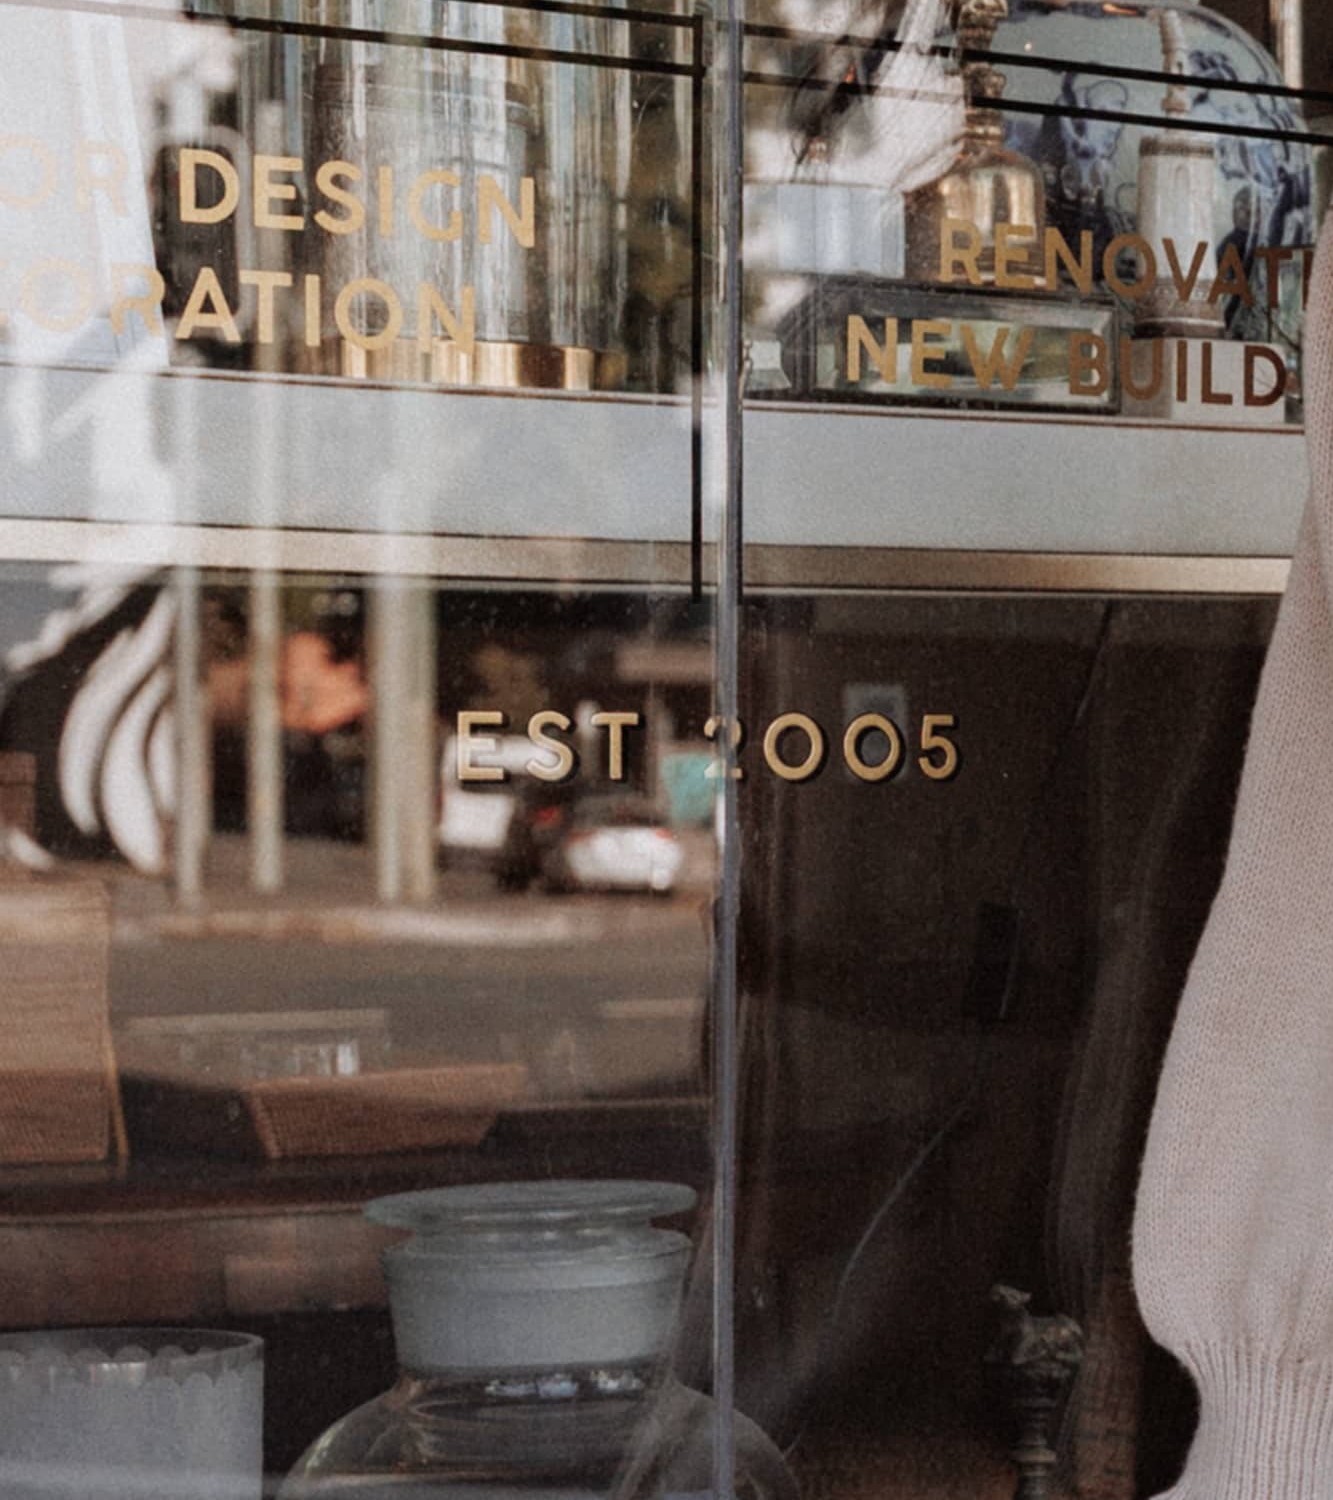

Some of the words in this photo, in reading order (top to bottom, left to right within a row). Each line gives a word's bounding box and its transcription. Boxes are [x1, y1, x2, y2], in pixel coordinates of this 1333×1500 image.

[178, 148, 536, 248] DESIGN
[0, 256, 476, 356] ORATION
[846, 314, 1034, 392] NEW
[1069, 332, 1288, 408] BUILD
[456, 711, 640, 781] EST
[703, 712, 958, 782] 2005
